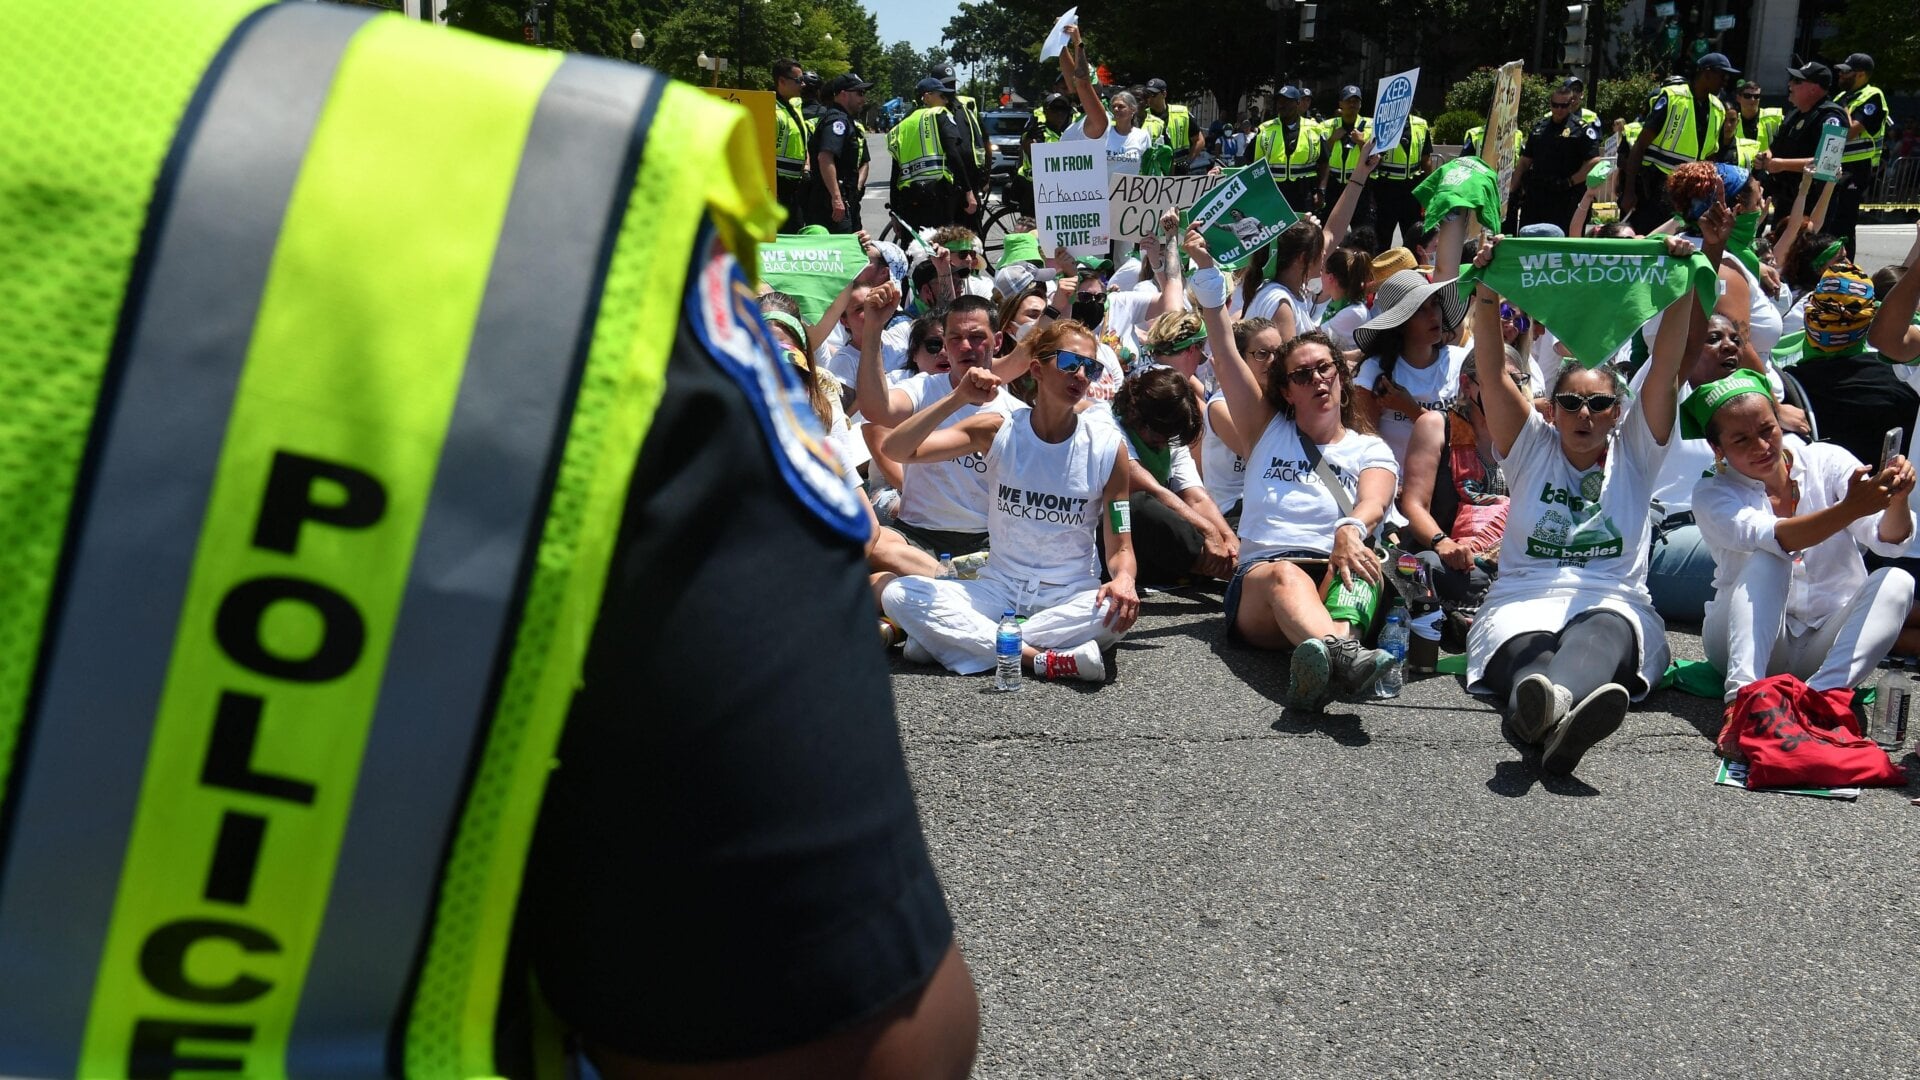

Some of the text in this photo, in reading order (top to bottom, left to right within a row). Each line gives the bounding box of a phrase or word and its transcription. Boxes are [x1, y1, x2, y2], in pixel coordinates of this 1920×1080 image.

[1386, 78, 1409, 101] KEEP
[1044, 155, 1093, 172] I'M FROM
[1038, 182, 1104, 203] Arkansas
[1109, 176, 1190, 204] ABORT
[1197, 181, 1240, 227] bans off
[1045, 213, 1100, 230] A TRIGGER
[1056, 231, 1090, 247] STATE
[1219, 219, 1287, 262] our bodies
[760, 249, 841, 262] WE WON'T
[1518, 253, 1562, 271] WE
[764, 261, 844, 272] BACK DOWN
[1521, 266, 1667, 288] BACK DOWN
[963, 455, 987, 473] DO
[1263, 468, 1302, 482] BACK
[999, 484, 1088, 511] WE WON'T
[997, 498, 1086, 525] BACK DOWN
[1532, 544, 1618, 557] our bodies
[126, 449, 389, 1080] POLICE
